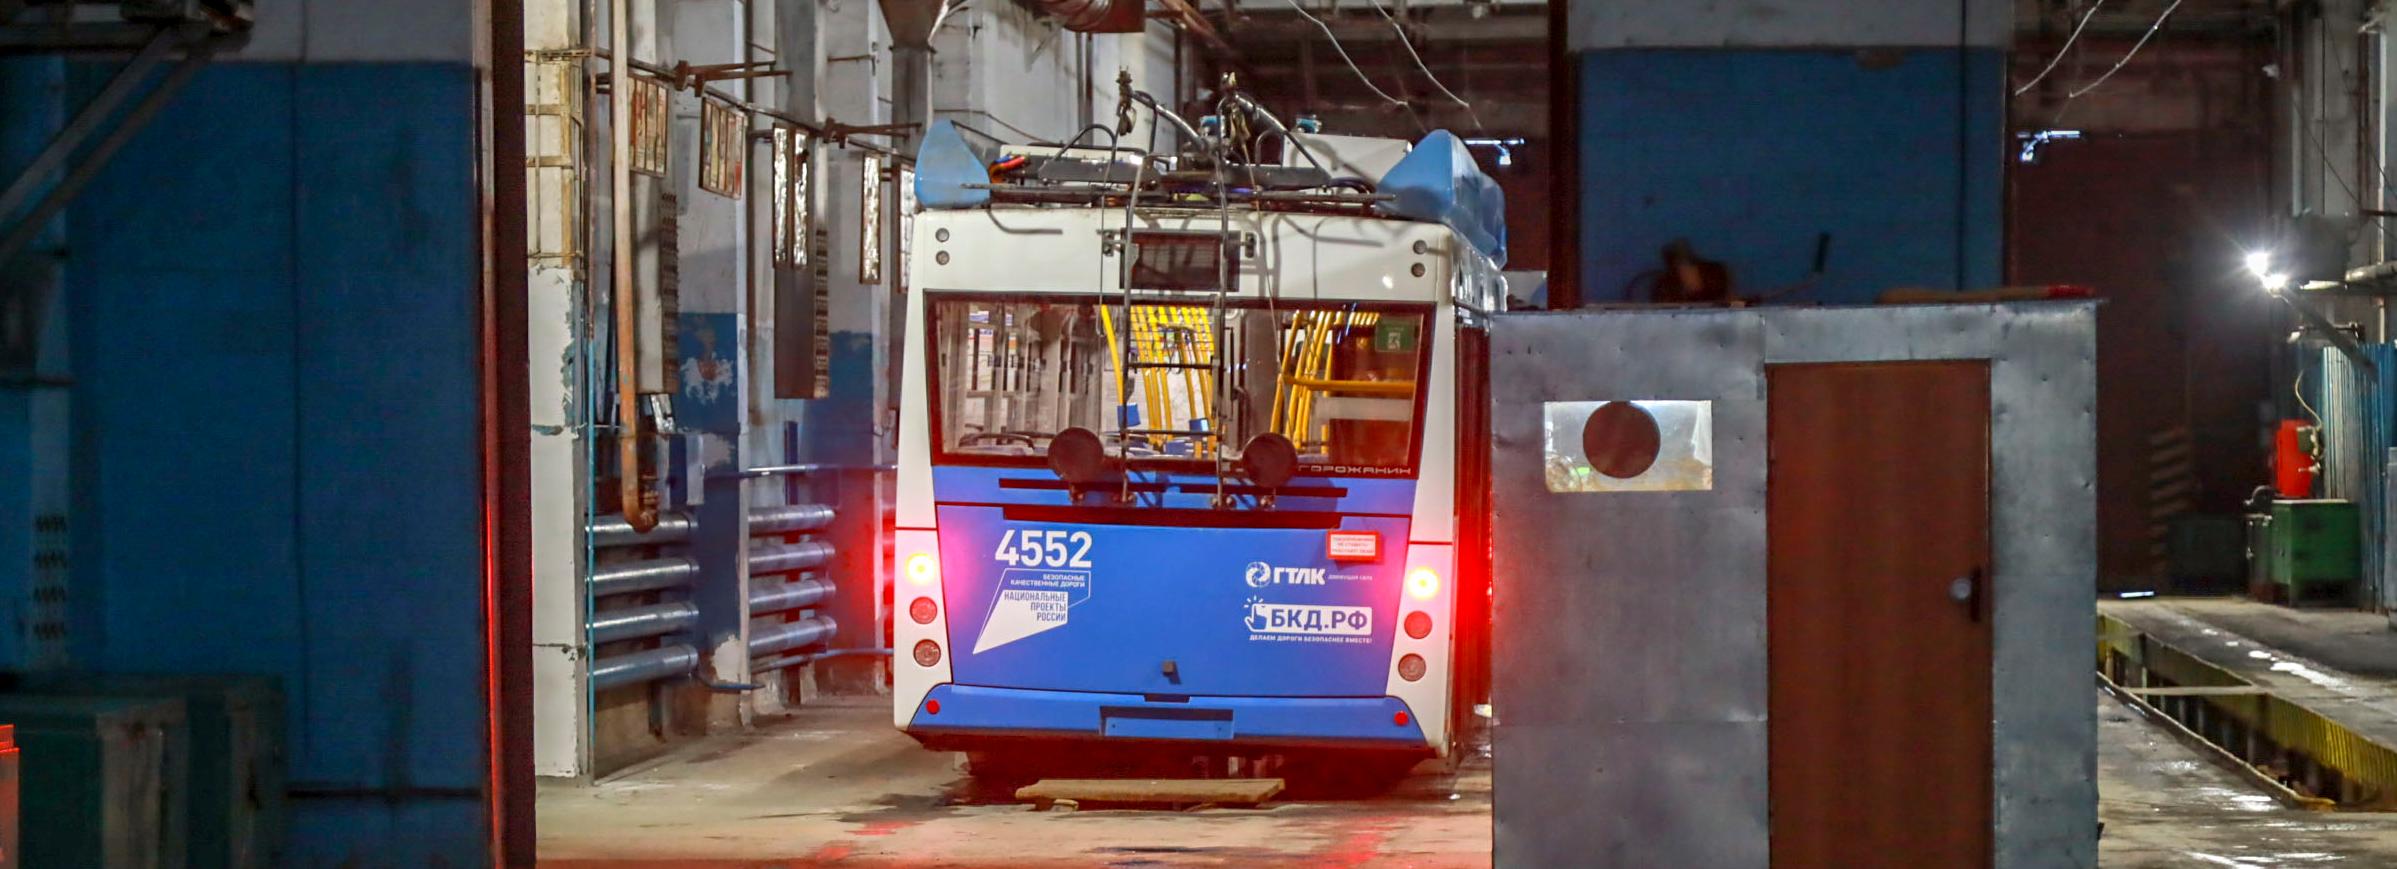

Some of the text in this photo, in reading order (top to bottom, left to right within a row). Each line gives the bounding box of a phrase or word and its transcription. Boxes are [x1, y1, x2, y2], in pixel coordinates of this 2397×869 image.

[1298, 464, 1411, 474] ГОРОЖАНИН
[995, 529, 1093, 568] 4552
[1043, 573, 1085, 581] БЕЗОПАСНЫЕ
[1273, 566, 1326, 585] ГТЛК
[1010, 579, 1059, 588] КАЧЕСТВЕННЫЕ
[1004, 591, 1067, 602] НАЦИОНАЛЬНЫЕ
[1030, 602, 1067, 612] ПРОЕКТЫ
[1036, 612, 1067, 622] РОССИИ
[1271, 608, 1368, 631] БКД.РФ
[1304, 636, 1344, 644] БЕЗОПАСНЕЕ
